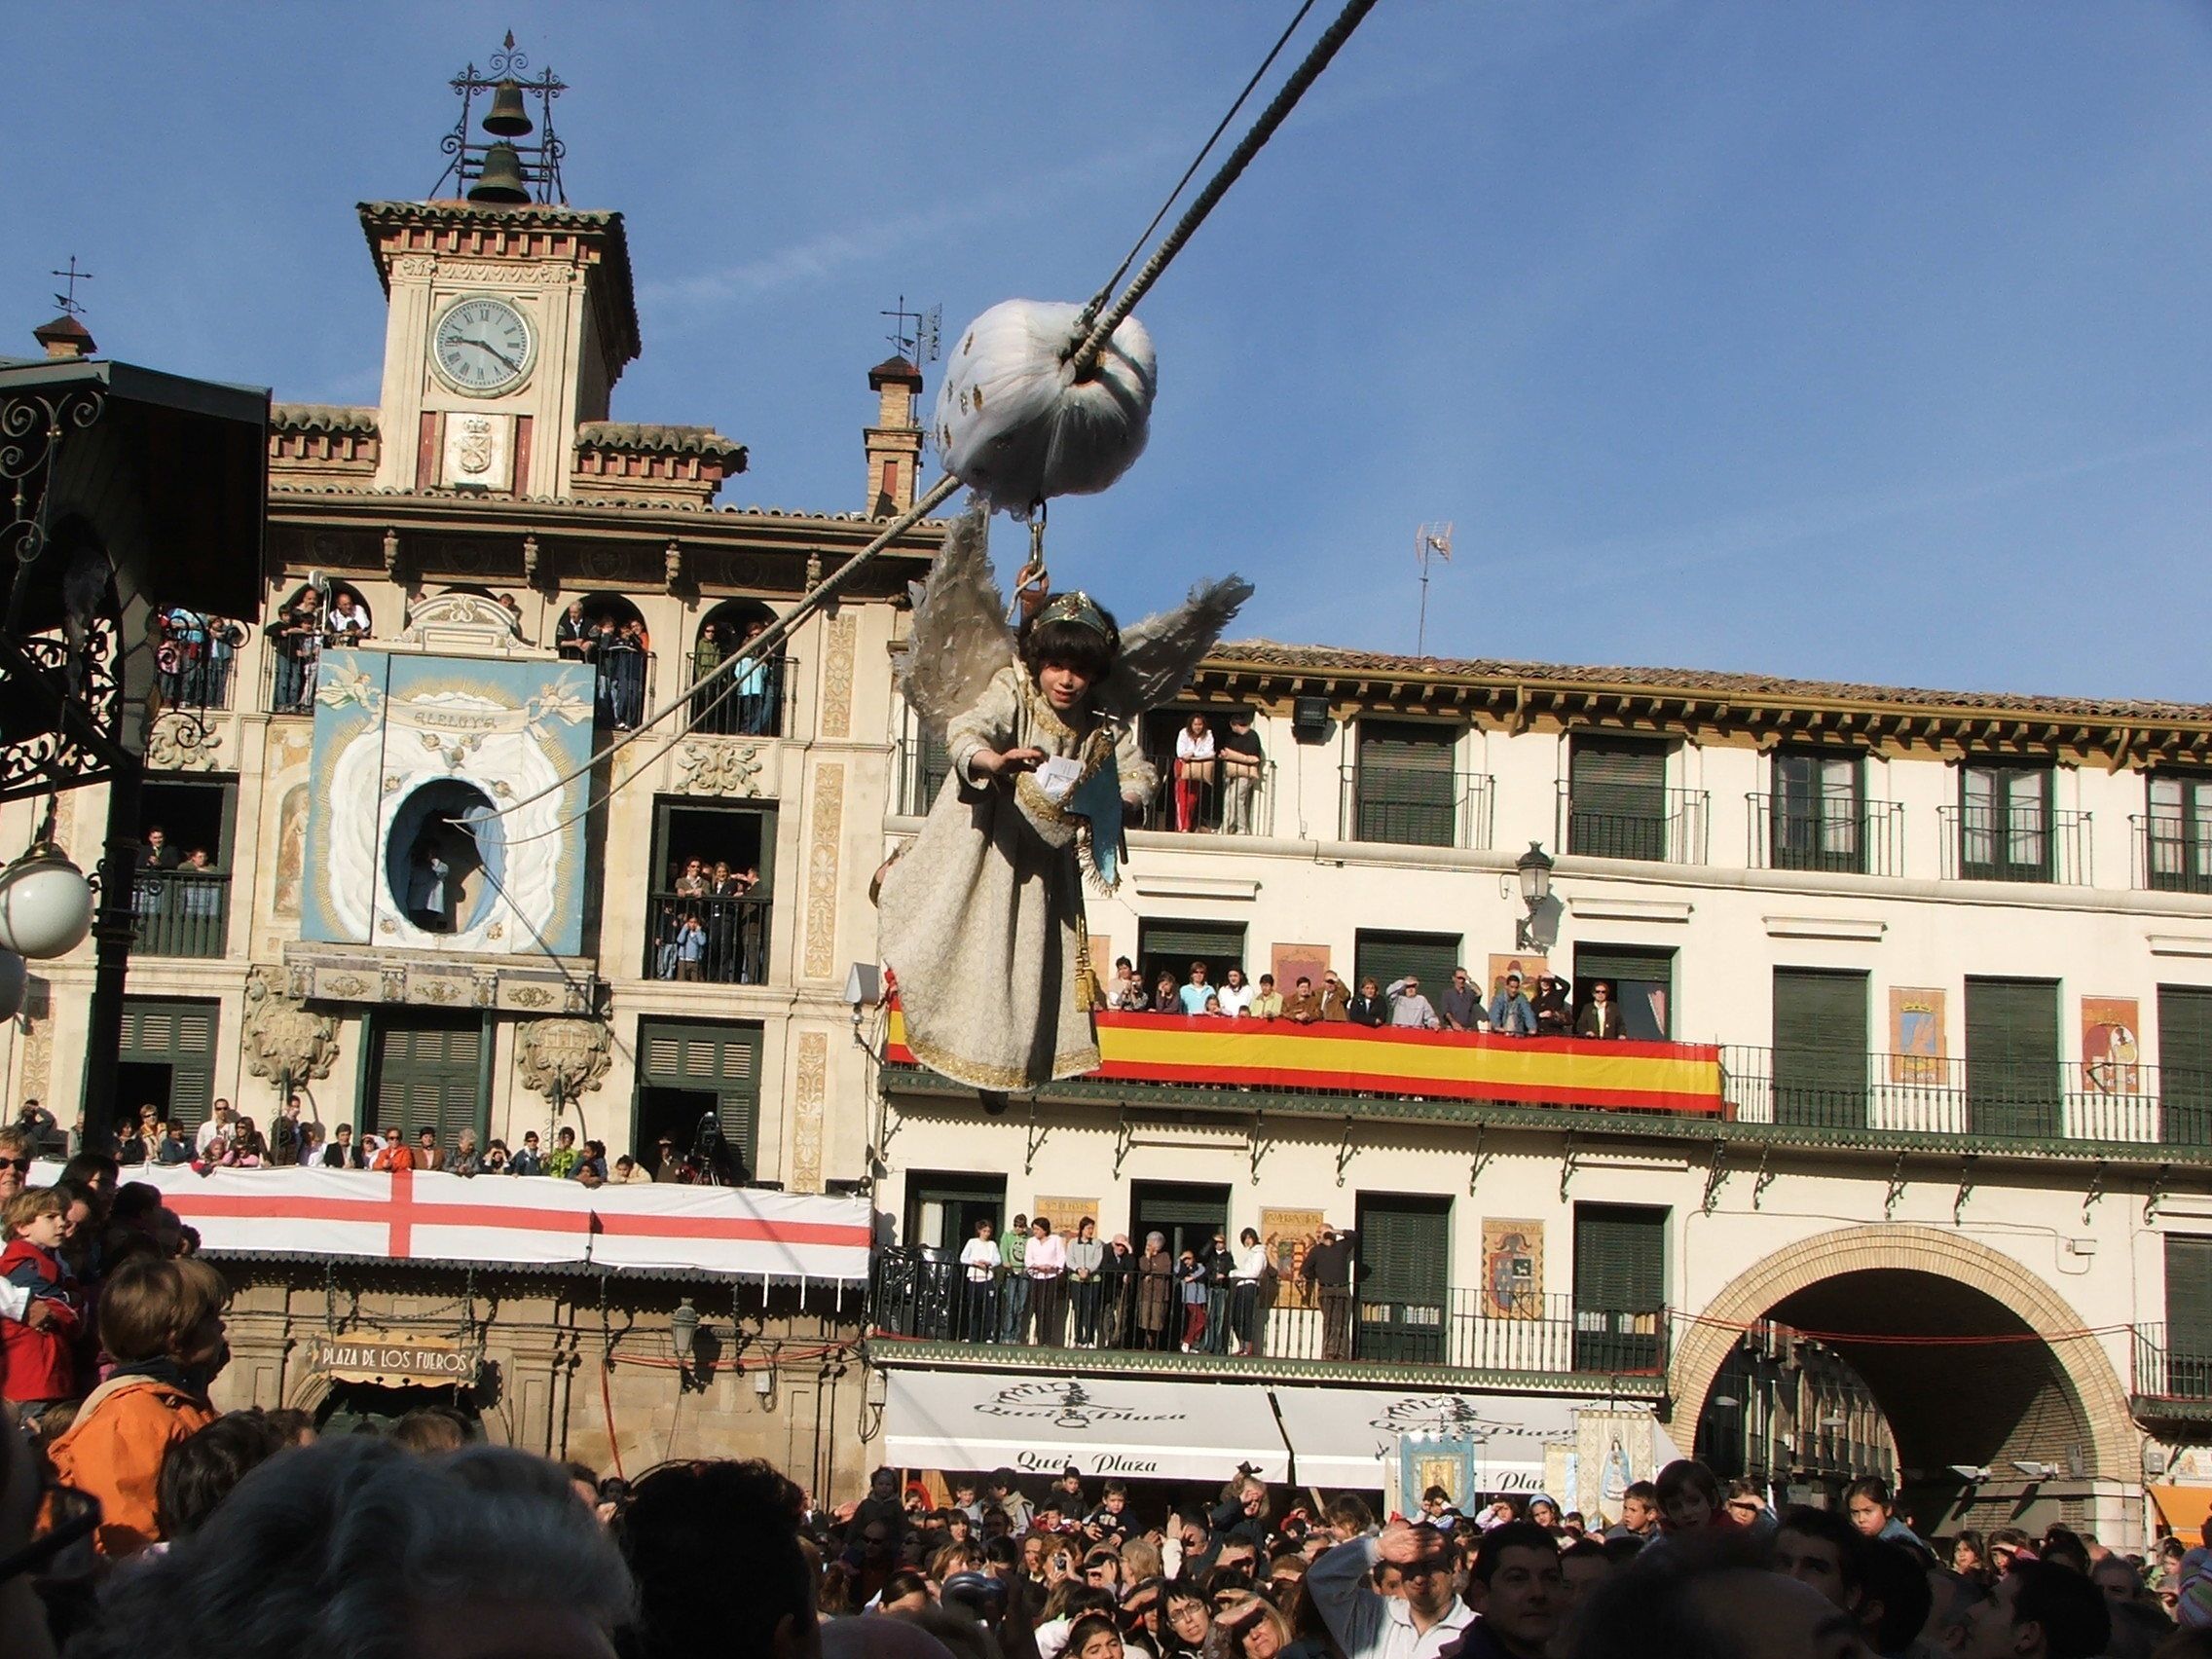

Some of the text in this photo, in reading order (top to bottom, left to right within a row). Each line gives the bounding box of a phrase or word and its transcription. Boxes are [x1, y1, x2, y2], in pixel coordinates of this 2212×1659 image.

[322, 1347, 467, 1372] PLAZA DE LOS FUEROS
[974, 1403, 1187, 1421] Quei Plaza
[1017, 1450, 1159, 1473] Quei Plaza
